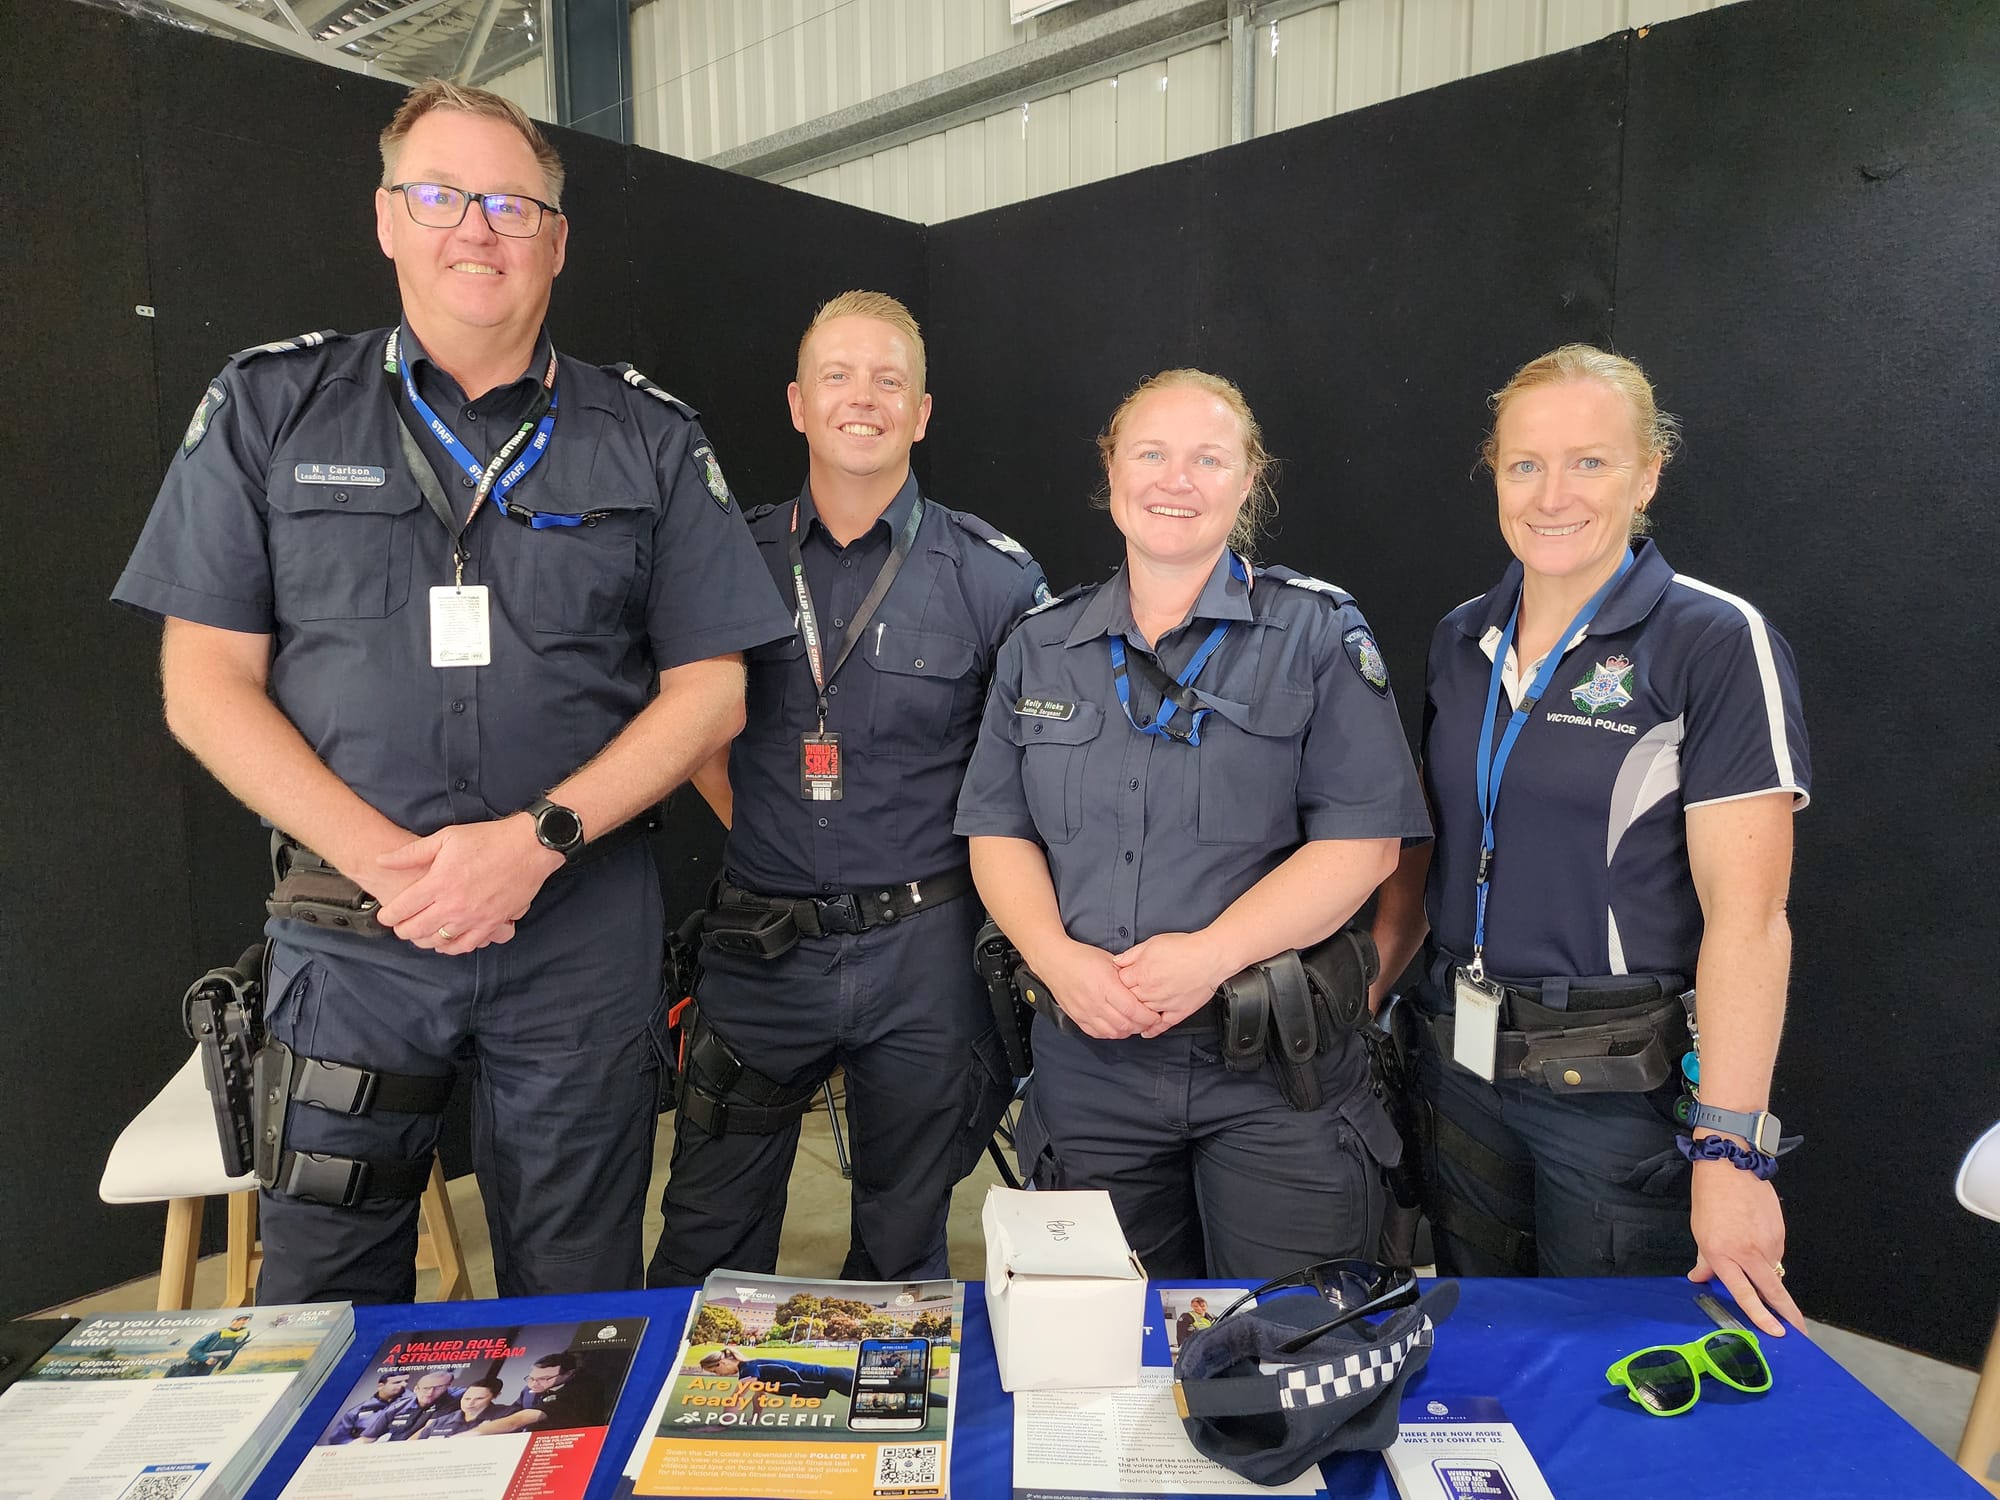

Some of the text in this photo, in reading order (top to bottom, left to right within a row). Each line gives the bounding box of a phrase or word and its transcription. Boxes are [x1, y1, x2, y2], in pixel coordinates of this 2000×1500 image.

[432, 420, 455, 444] STAFF
[533, 431, 548, 450] STAFF
[480, 430, 527, 493] PHILLIP ISLAND
[301, 473, 326, 481] Leading
[329, 466, 370, 475] Carlson
[501, 461, 526, 487] STAFF
[794, 575, 823, 687] PHILLIP ISLAND CIRCUIT
[1024, 699, 1065, 711] Kelly Hicks
[1546, 712, 1638, 735] VICTORIA POLICE
[87, 1316, 220, 1331] Are you looking
[79, 1327, 178, 1338] for a career
[70, 1337, 110, 1347] with
[389, 1337, 508, 1354] A VALUED ROLE,
[382, 1346, 527, 1365] A STRONGER TEAM
[688, 1377, 781, 1395] Are you
[681, 1392, 822, 1411] ready to be
[666, 1448, 687, 1456] Scan
[1472, 1470, 1491, 1478] YOU
